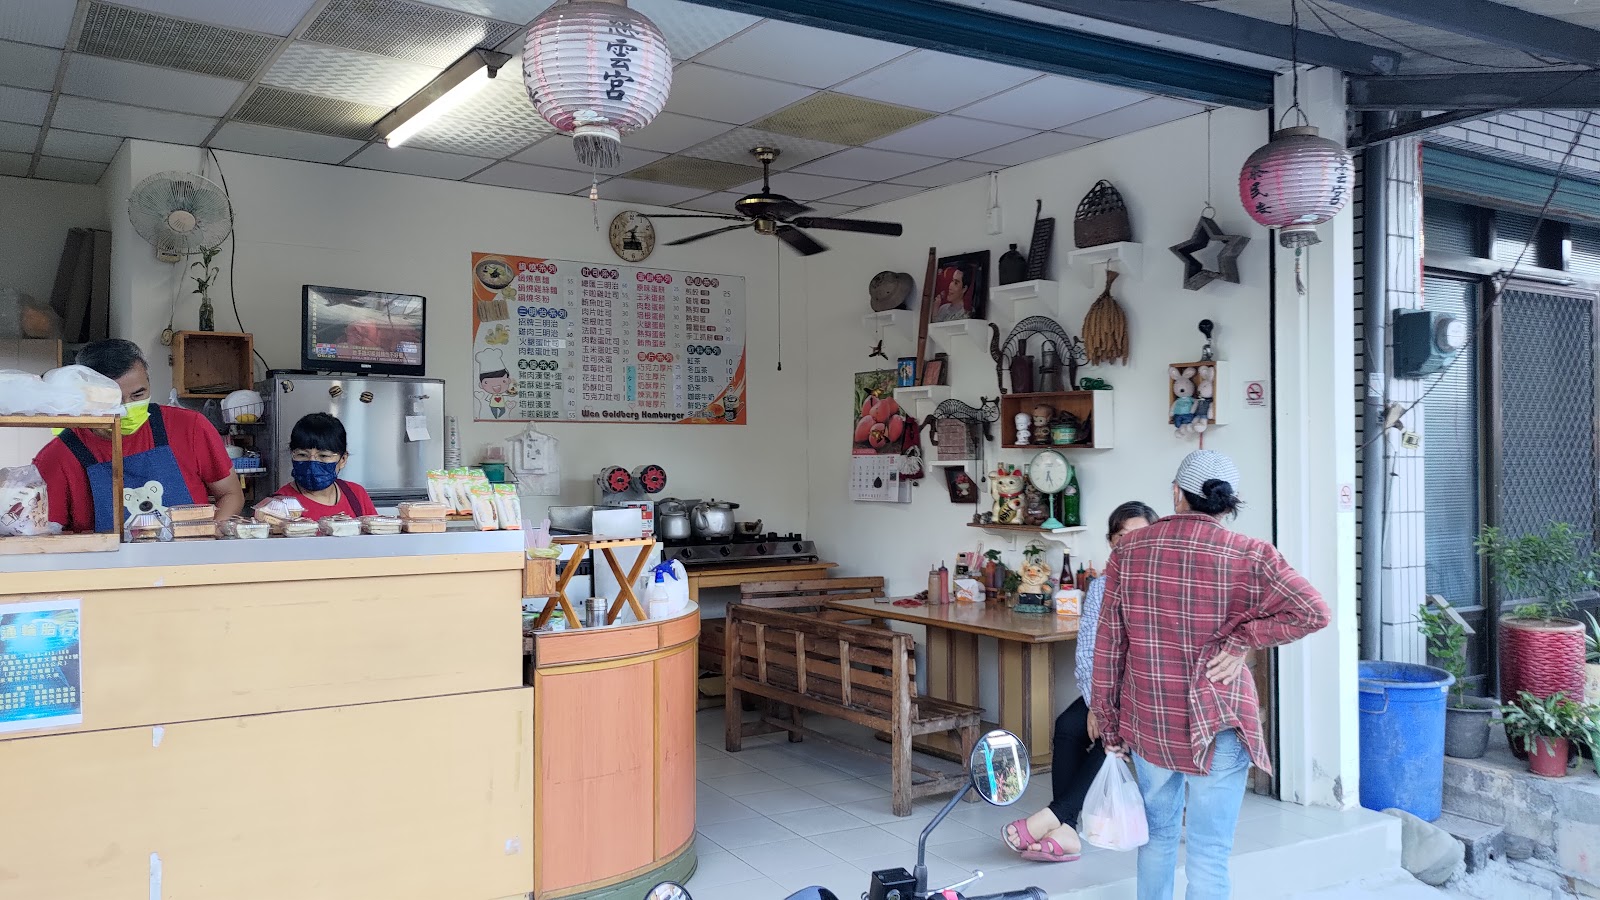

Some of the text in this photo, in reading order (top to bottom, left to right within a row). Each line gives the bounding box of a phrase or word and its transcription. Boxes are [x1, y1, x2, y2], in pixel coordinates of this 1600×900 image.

[581, 267, 619, 280] 吐司系列
[518, 294, 549, 303] 鍋燒冬粉
[637, 293, 665, 302] 玉米蛋餅
[582, 298, 611, 308] 鮪魚吐司
[637, 303, 665, 311] 肉鬆蛋餅
[517, 306, 568, 319] 三明治系列
[582, 308, 612, 317] 肉片吐司
[518, 318, 558, 328] 招牌三明治
[582, 317, 612, 326] 培根吐司
[637, 321, 666, 330] 火腿蛋餅
[518, 328, 558, 337] 雞肉三明治
[637, 330, 666, 338] 熱狗蛋餅
[519, 338, 559, 347] 火腿蛋吐司
[582, 337, 620, 345] 肉鬆蛋吐司
[637, 339, 666, 347] 鮪魚蛋餅
[518, 347, 559, 356] 肉鬆蛋吐司
[582, 345, 620, 354] 玉米蛋吐司
[687, 366, 708, 374] 冬瓜茶
[583, 374, 612, 382] 花生吐司
[583, 383, 612, 391] 奶酥吐司
[583, 393, 620, 401] 巧克力吐司
[519, 400, 551, 409] 培根漢堡
[582, 410, 685, 420] Wen Goldberg Hamburger
